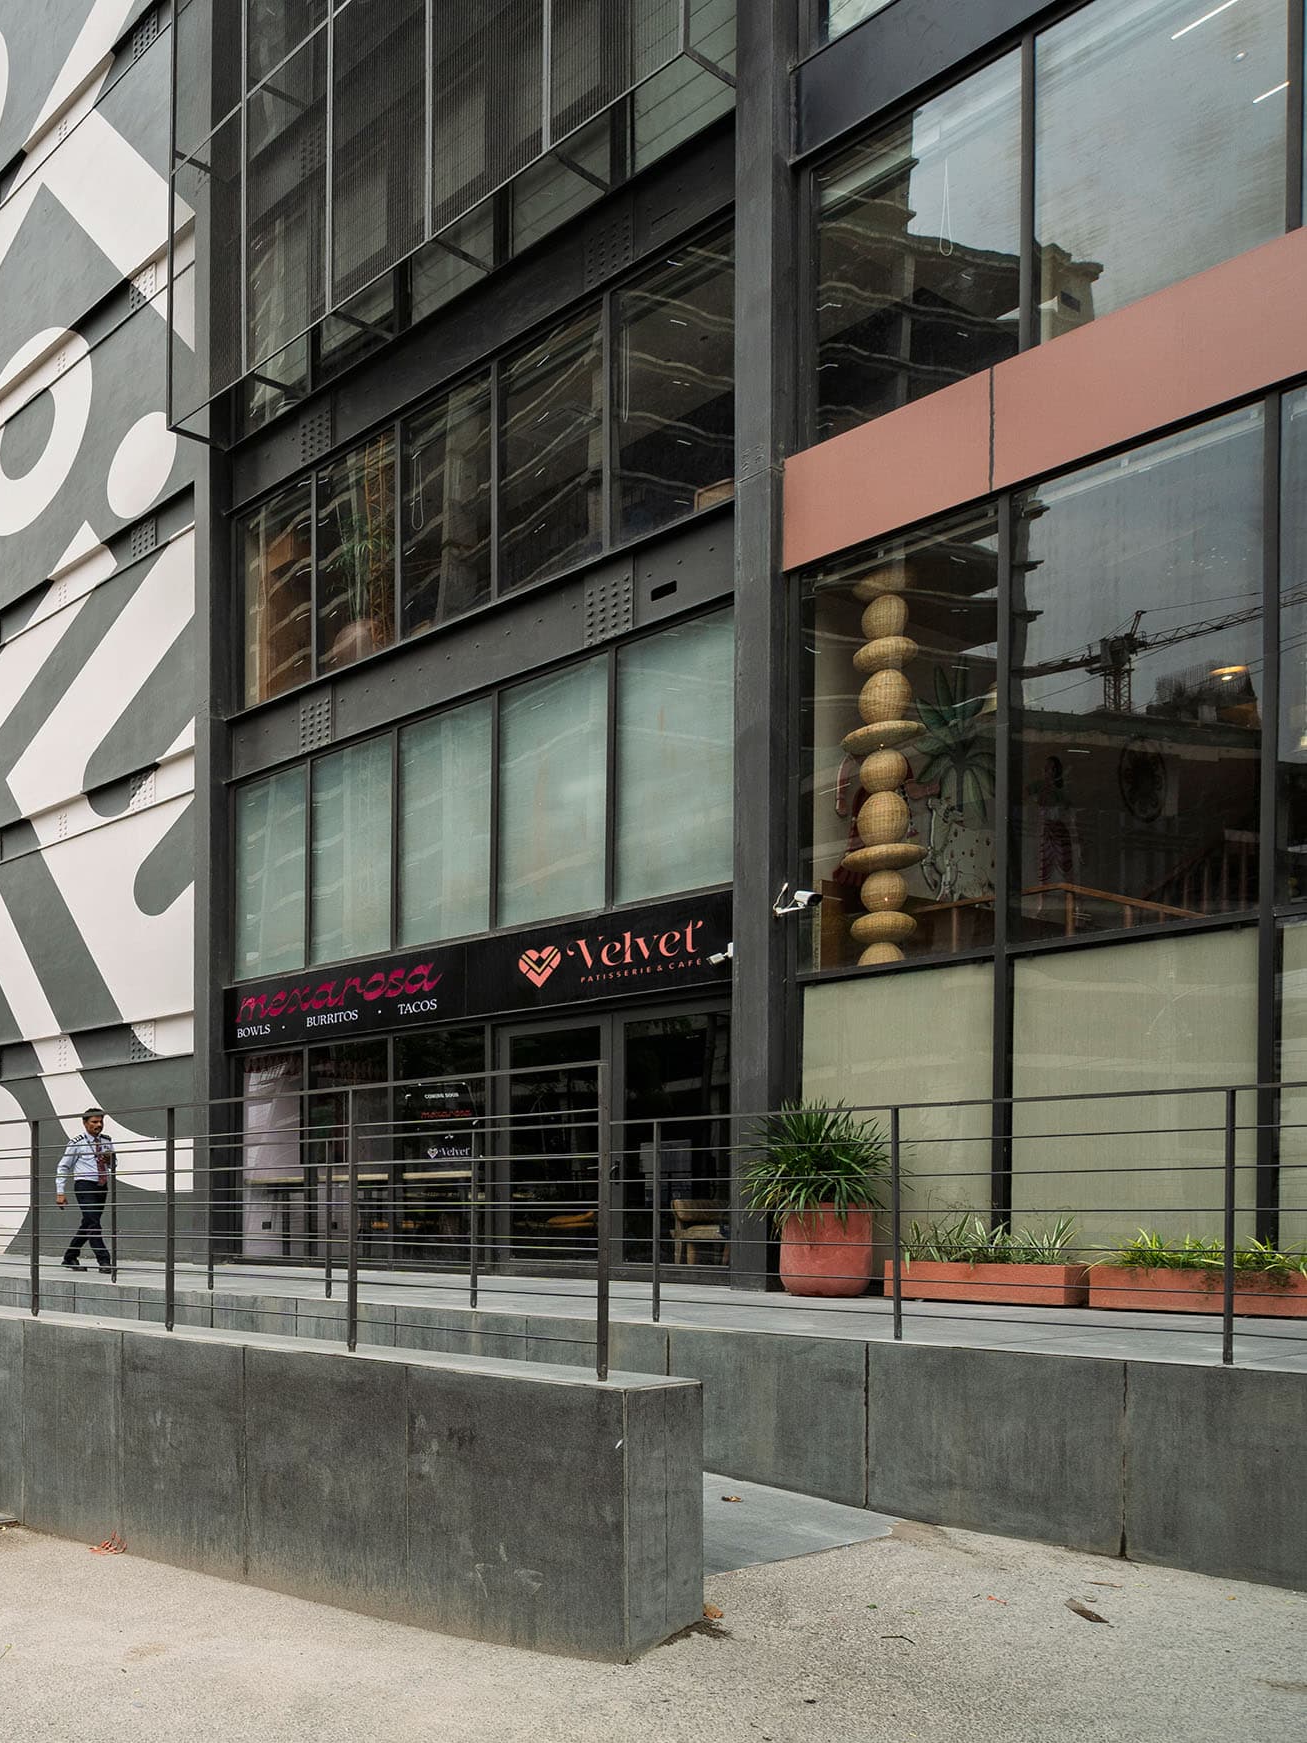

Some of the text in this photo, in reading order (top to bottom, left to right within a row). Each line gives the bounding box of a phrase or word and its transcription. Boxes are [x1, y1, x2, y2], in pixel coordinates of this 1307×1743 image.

[566, 920, 703, 969] Velvet
[235, 962, 443, 1023] mexarosa
[580, 966, 652, 983] PATISSERIE
[656, 964, 663, 972] &
[237, 998, 438, 1038] BOWLS BURRITOS TACOS
